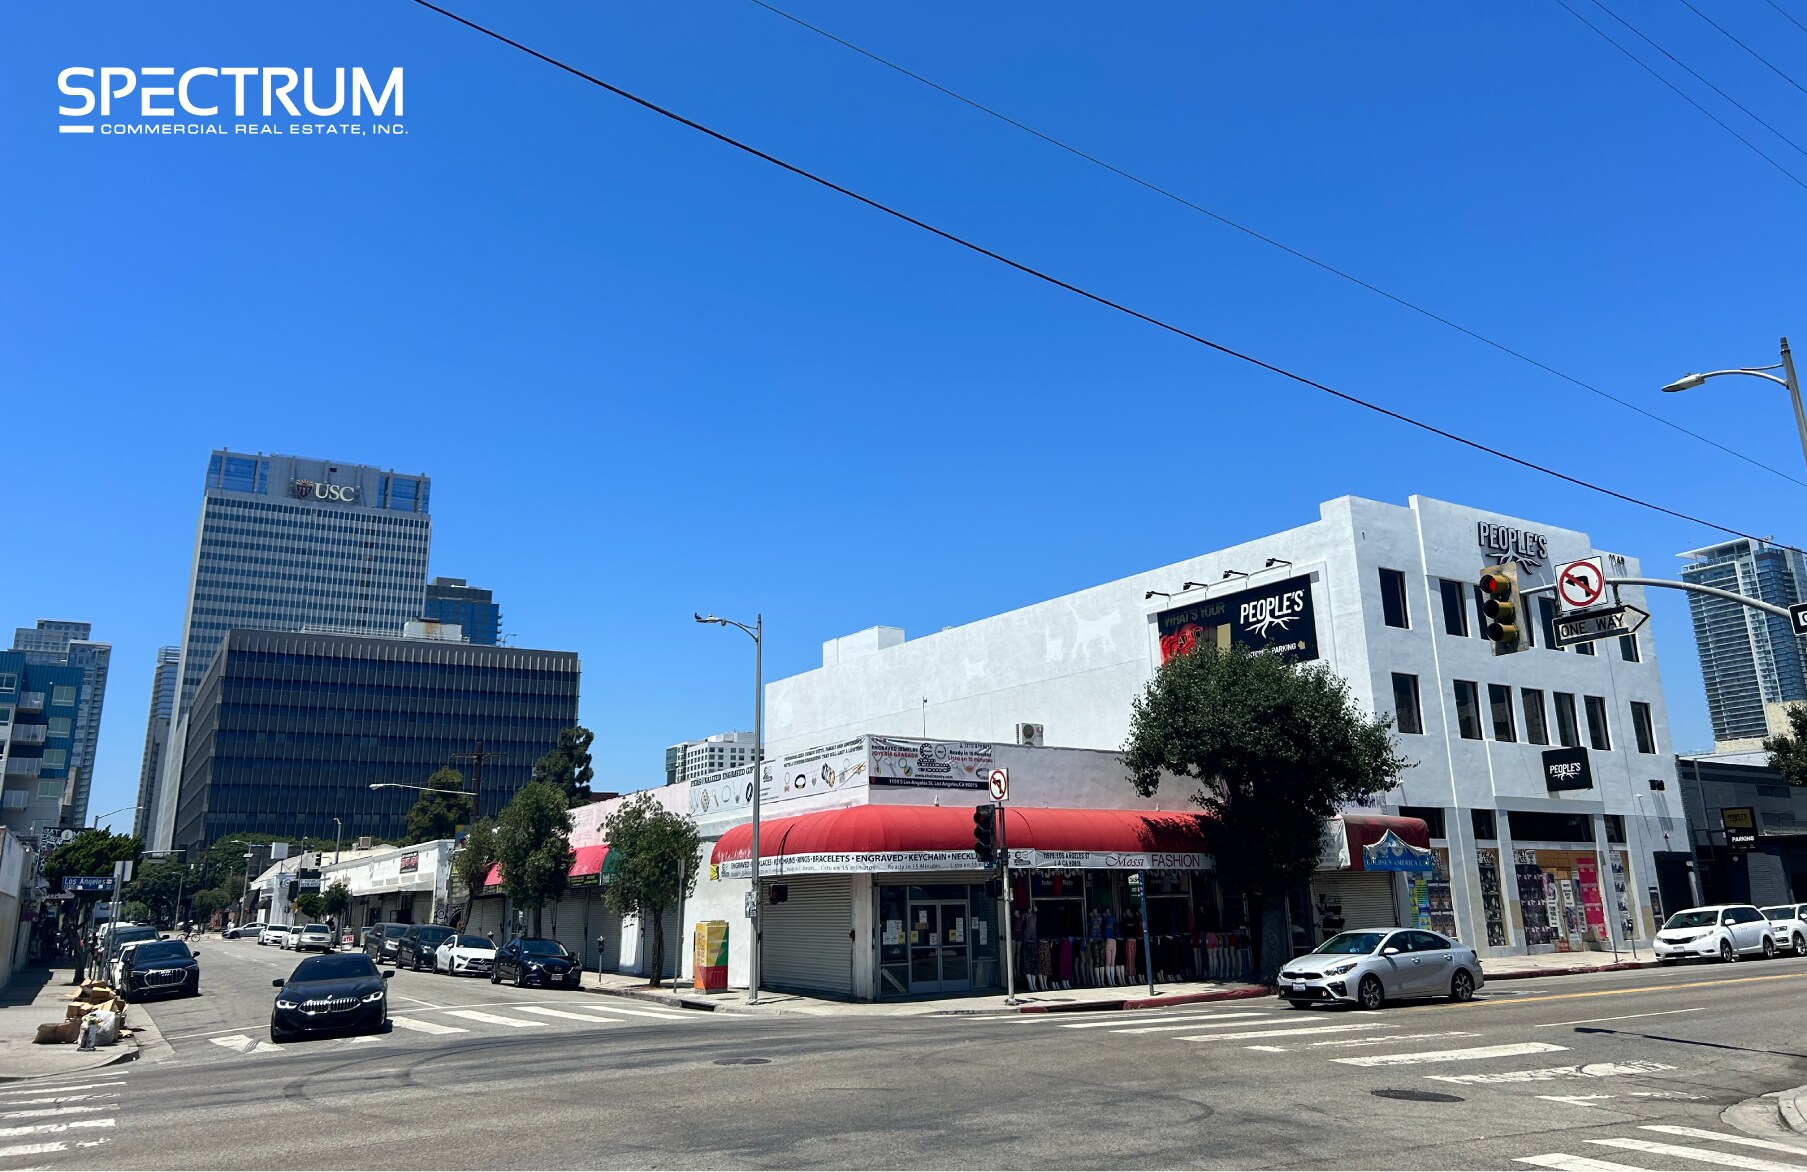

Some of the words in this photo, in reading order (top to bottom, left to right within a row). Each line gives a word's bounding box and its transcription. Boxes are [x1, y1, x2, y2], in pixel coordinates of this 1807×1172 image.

[314, 482, 356, 502] USC
[1478, 521, 1548, 559] PEOPLE'S
[1240, 589, 1305, 625] PEOPLE'S
[1163, 610, 1199, 628] WHAT'S
[1201, 602, 1226, 619] YOUR
[1560, 621, 1588, 638] ONE
[1595, 614, 1624, 634] WAY
[1271, 643, 1297, 655] PARKING
[1549, 762, 1581, 775] PEOPLE'S
[1731, 835, 1755, 843] PARKING
[812, 854, 850, 863] BRACELETS
[855, 854, 903, 863] ENGRAVED
[908, 853, 947, 862] KEYCHAIN
[1105, 853, 1145, 867] Mossi
[1151, 854, 1200, 867] FASHION
[64, 877, 76, 885] Los
[80, 877, 106, 886] Angeles
